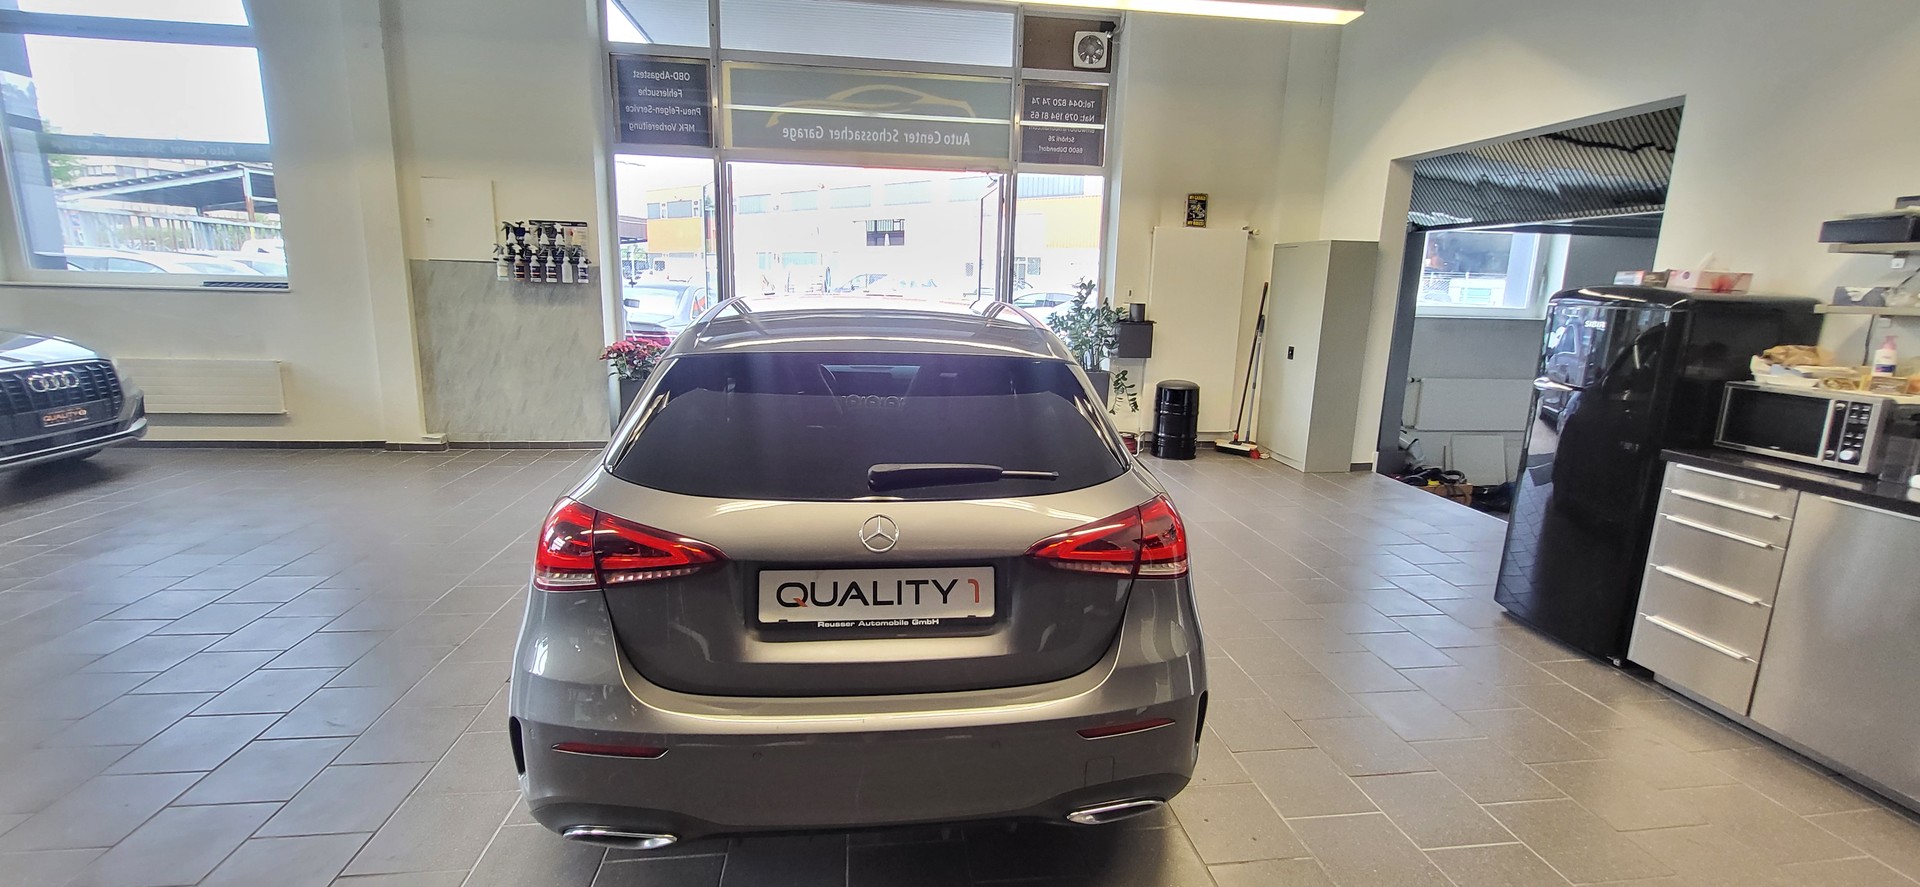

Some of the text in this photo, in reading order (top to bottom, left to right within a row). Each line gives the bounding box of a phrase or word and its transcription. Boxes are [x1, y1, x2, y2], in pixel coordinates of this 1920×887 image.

[776, 579, 959, 608] QUALITY
[817, 618, 940, 628] Reusser Automobile GmbH
